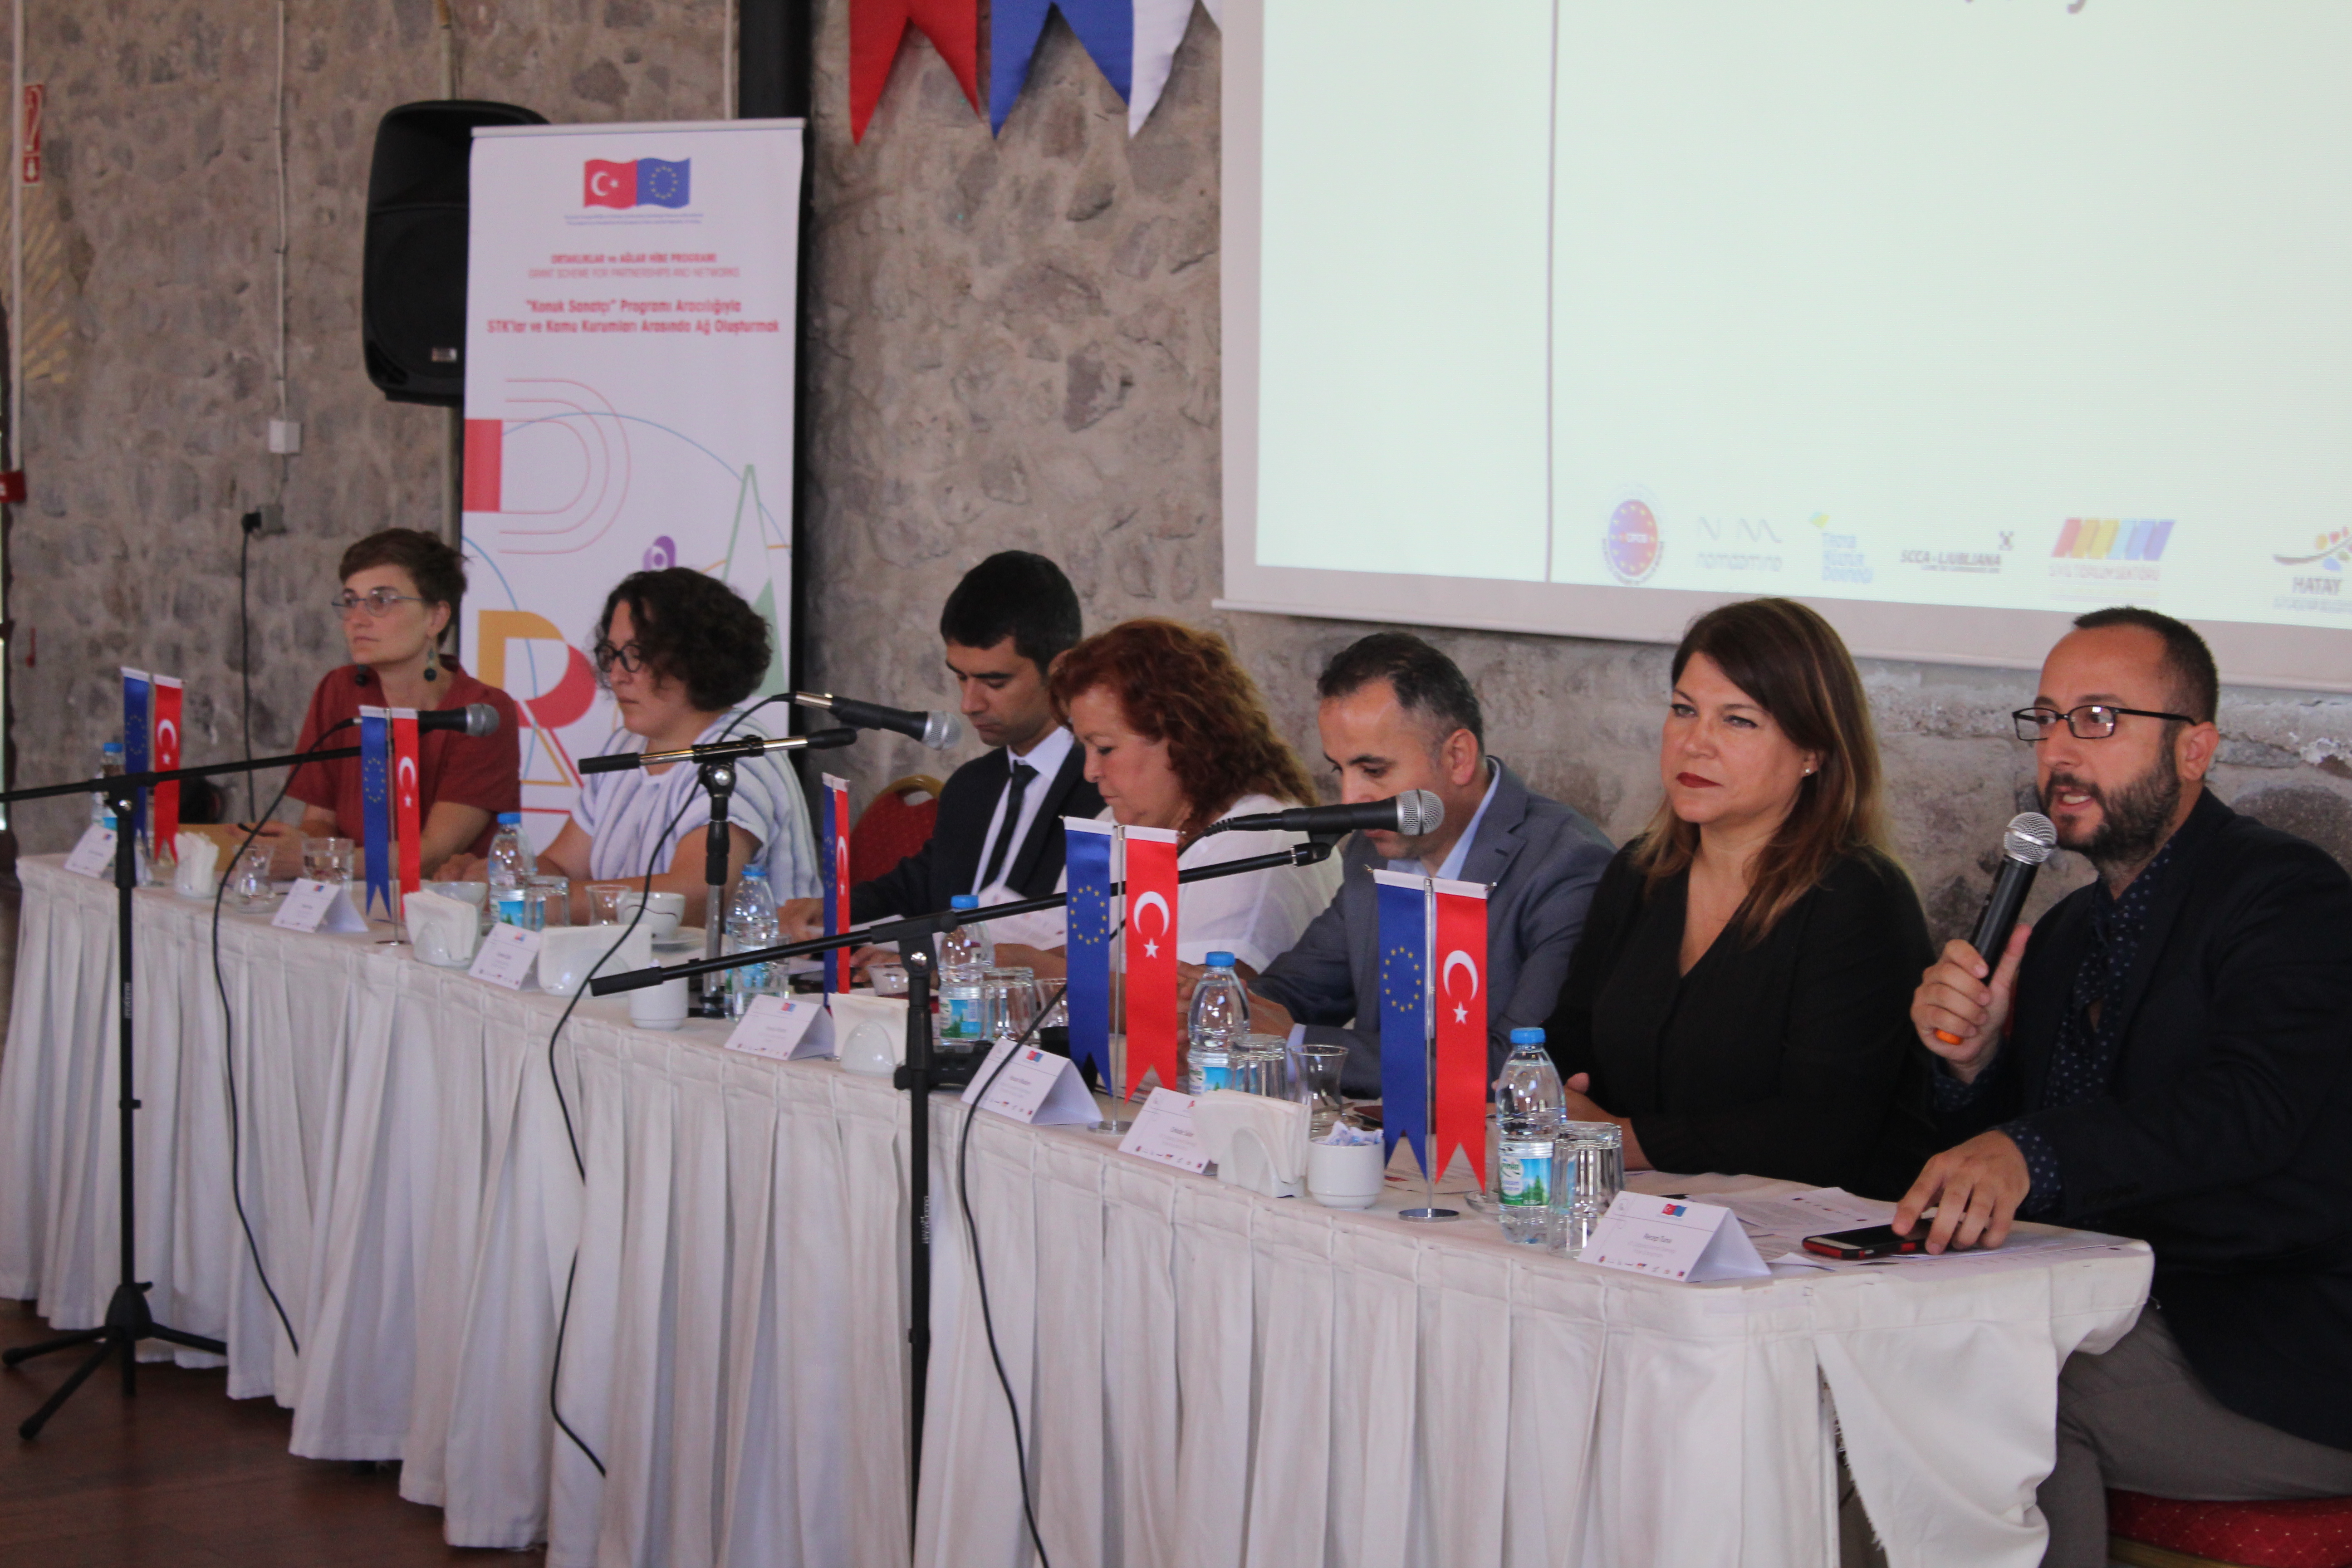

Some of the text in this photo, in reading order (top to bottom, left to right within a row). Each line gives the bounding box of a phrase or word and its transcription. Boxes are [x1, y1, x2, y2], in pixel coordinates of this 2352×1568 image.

[620, 299, 672, 316] Programı
[529, 322, 542, 333] ve
[546, 320, 578, 333] Kamu
[581, 320, 637, 333] Kurumları
[642, 320, 692, 333] Arasında
[695, 319, 711, 336] Ağ
[714, 319, 780, 336] Oluşturmak
[2292, 576, 2343, 596] HATAY
